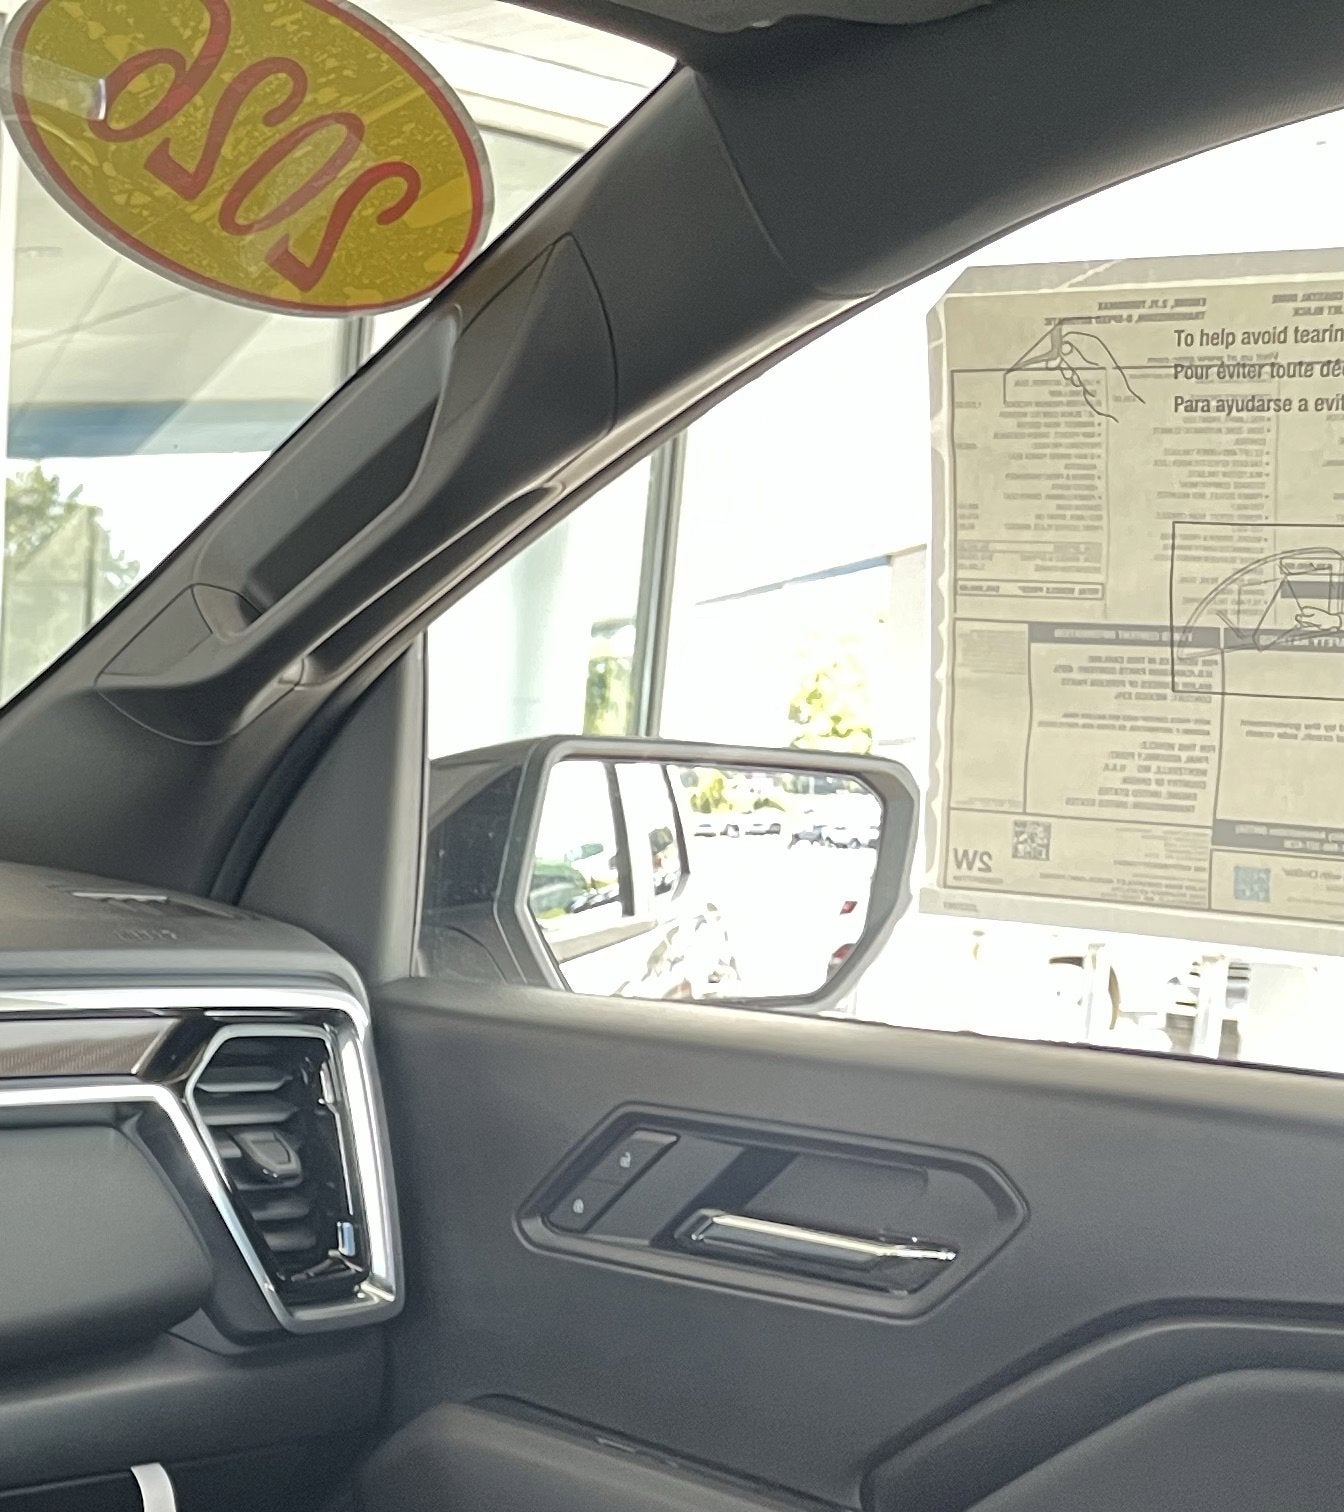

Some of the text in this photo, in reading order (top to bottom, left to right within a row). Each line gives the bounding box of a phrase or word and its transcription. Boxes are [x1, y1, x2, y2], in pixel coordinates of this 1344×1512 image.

[1174, 329, 1194, 348] To
[1200, 327, 1235, 349] help
[1241, 326, 1288, 346] avoid
[1173, 363, 1212, 381] Pour
[1216, 360, 1263, 380] éviter
[1269, 361, 1314, 379] toute
[1174, 395, 1211, 413] Para
[1216, 394, 1293, 417] ayudarse
[1298, 397, 1309, 412] a
